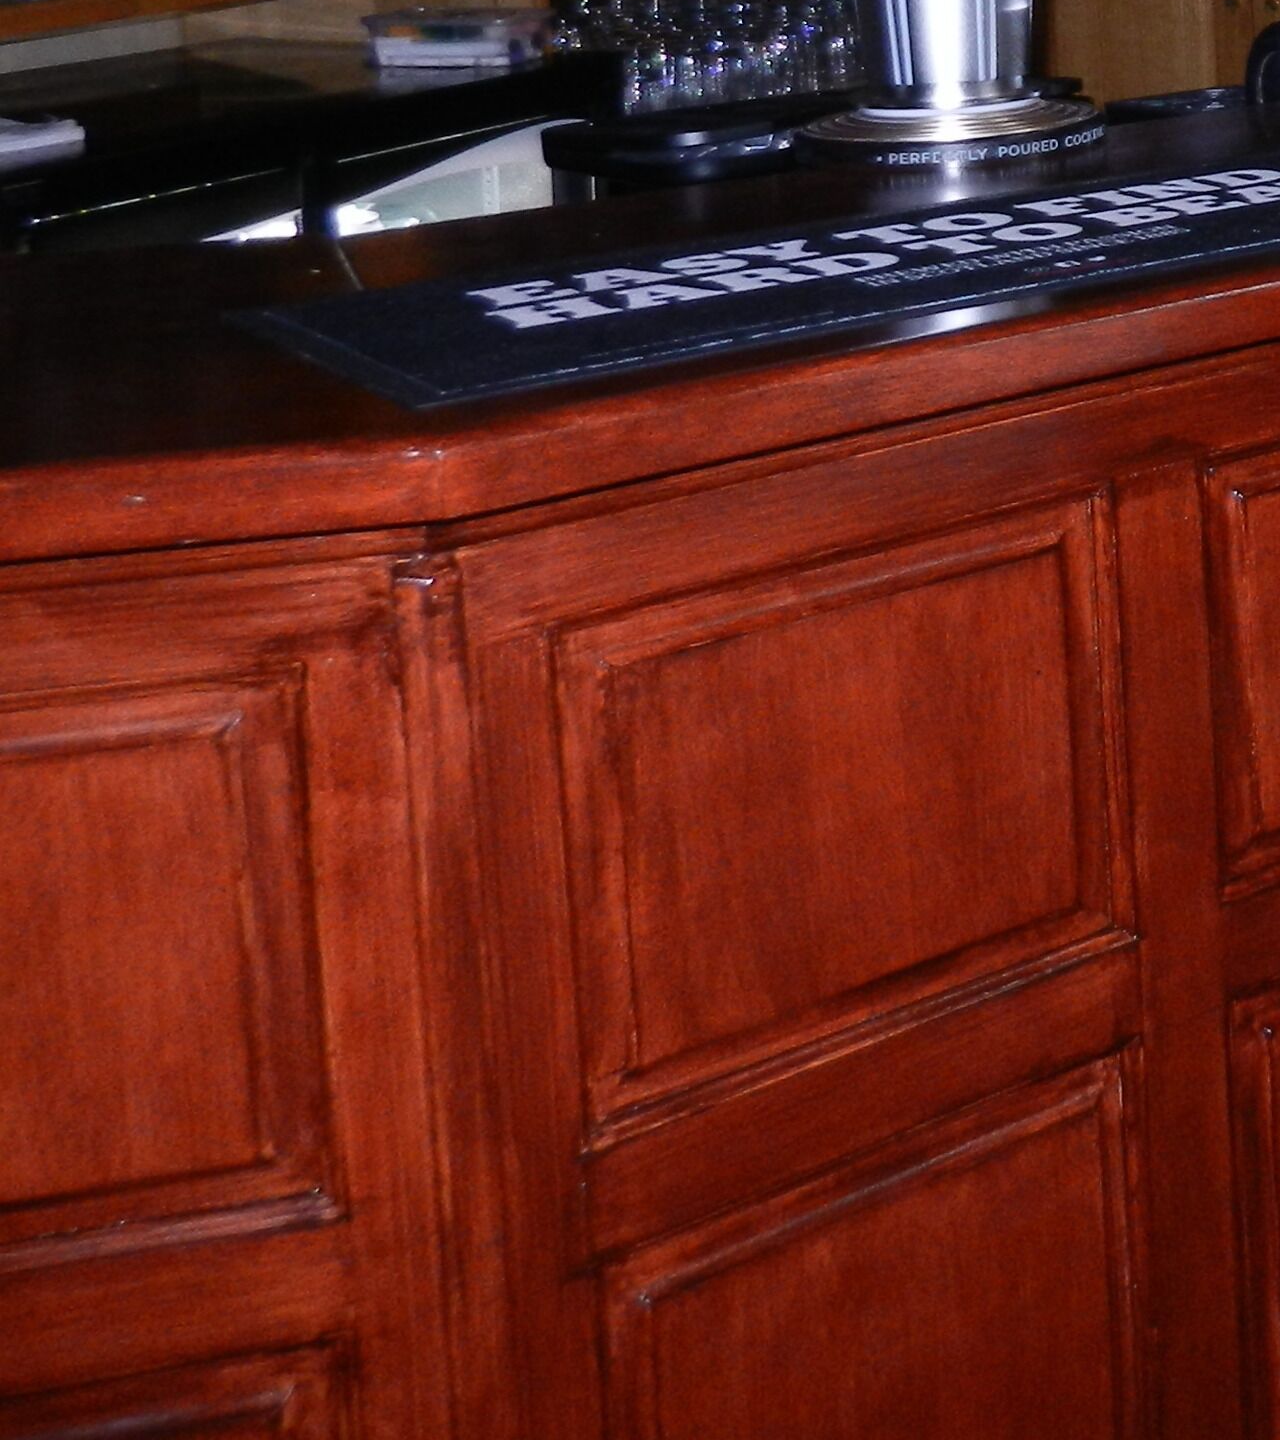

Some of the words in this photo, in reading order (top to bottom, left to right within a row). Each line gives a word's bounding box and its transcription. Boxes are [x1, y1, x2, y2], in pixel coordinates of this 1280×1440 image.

[998, 139, 1059, 158] POURED
[465, 238, 822, 309] EASY
[833, 211, 1014, 246] TO
[485, 251, 900, 330] HARD
[902, 222, 1083, 256] TO
